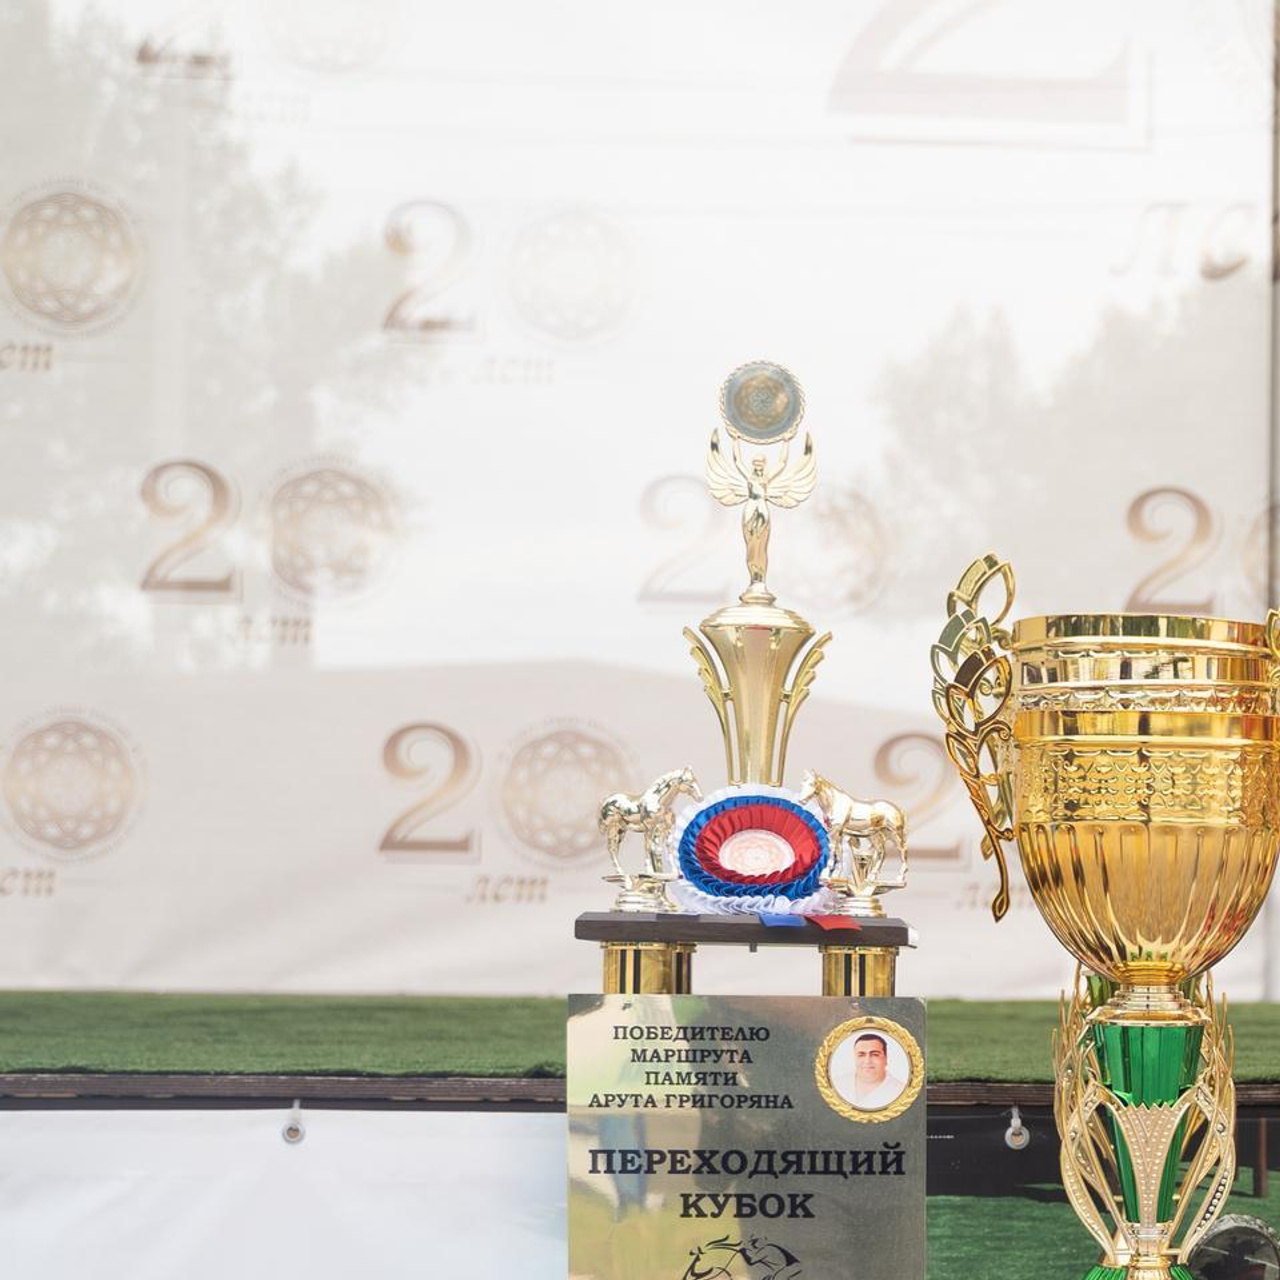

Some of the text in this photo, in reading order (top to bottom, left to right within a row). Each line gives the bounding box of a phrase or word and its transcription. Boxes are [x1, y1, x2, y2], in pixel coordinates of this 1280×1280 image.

[612, 1024, 771, 1043] ПОБЕДИТЕЛЮ
[630, 1048, 754, 1065] МАРШРУТА
[644, 1070, 739, 1087] ПАМЯТИ
[587, 1093, 795, 1111] АРУТА ГРИГОРЯНА
[588, 1141, 907, 1181] ПЕРЕХОДЯЩИЙ
[679, 1192, 816, 1219] КУБОК
